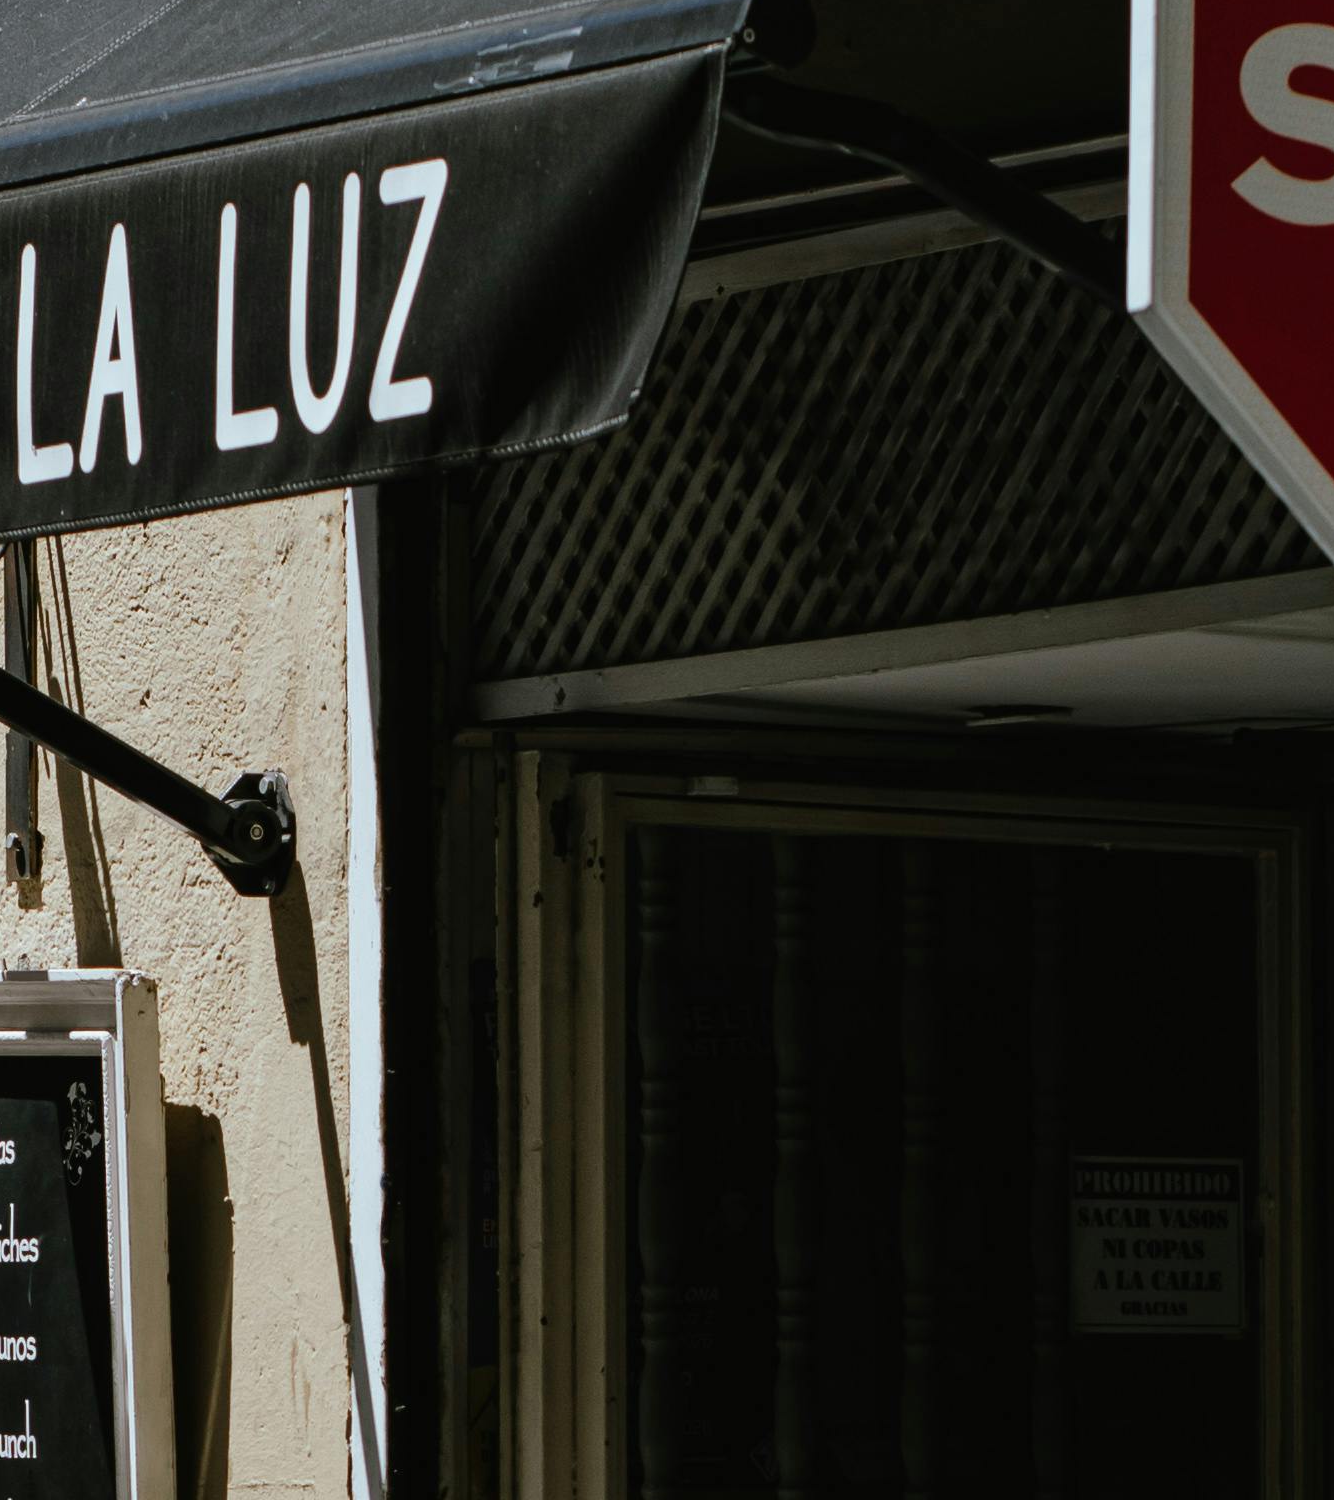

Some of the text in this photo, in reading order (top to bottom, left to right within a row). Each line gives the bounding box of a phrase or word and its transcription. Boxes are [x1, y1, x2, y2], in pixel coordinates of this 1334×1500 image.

[17, 222, 142, 485] LA
[216, 158, 448, 450] LUZ
[1075, 1170, 1231, 1196] PROHIBIDO
[1076, 1206, 1230, 1230] SACAR VASOS
[1102, 1238, 1206, 1260] NI COPAS
[1094, 1270, 1224, 1292] A LA CALLE
[1120, 1300, 1188, 1317] GRACIAS
